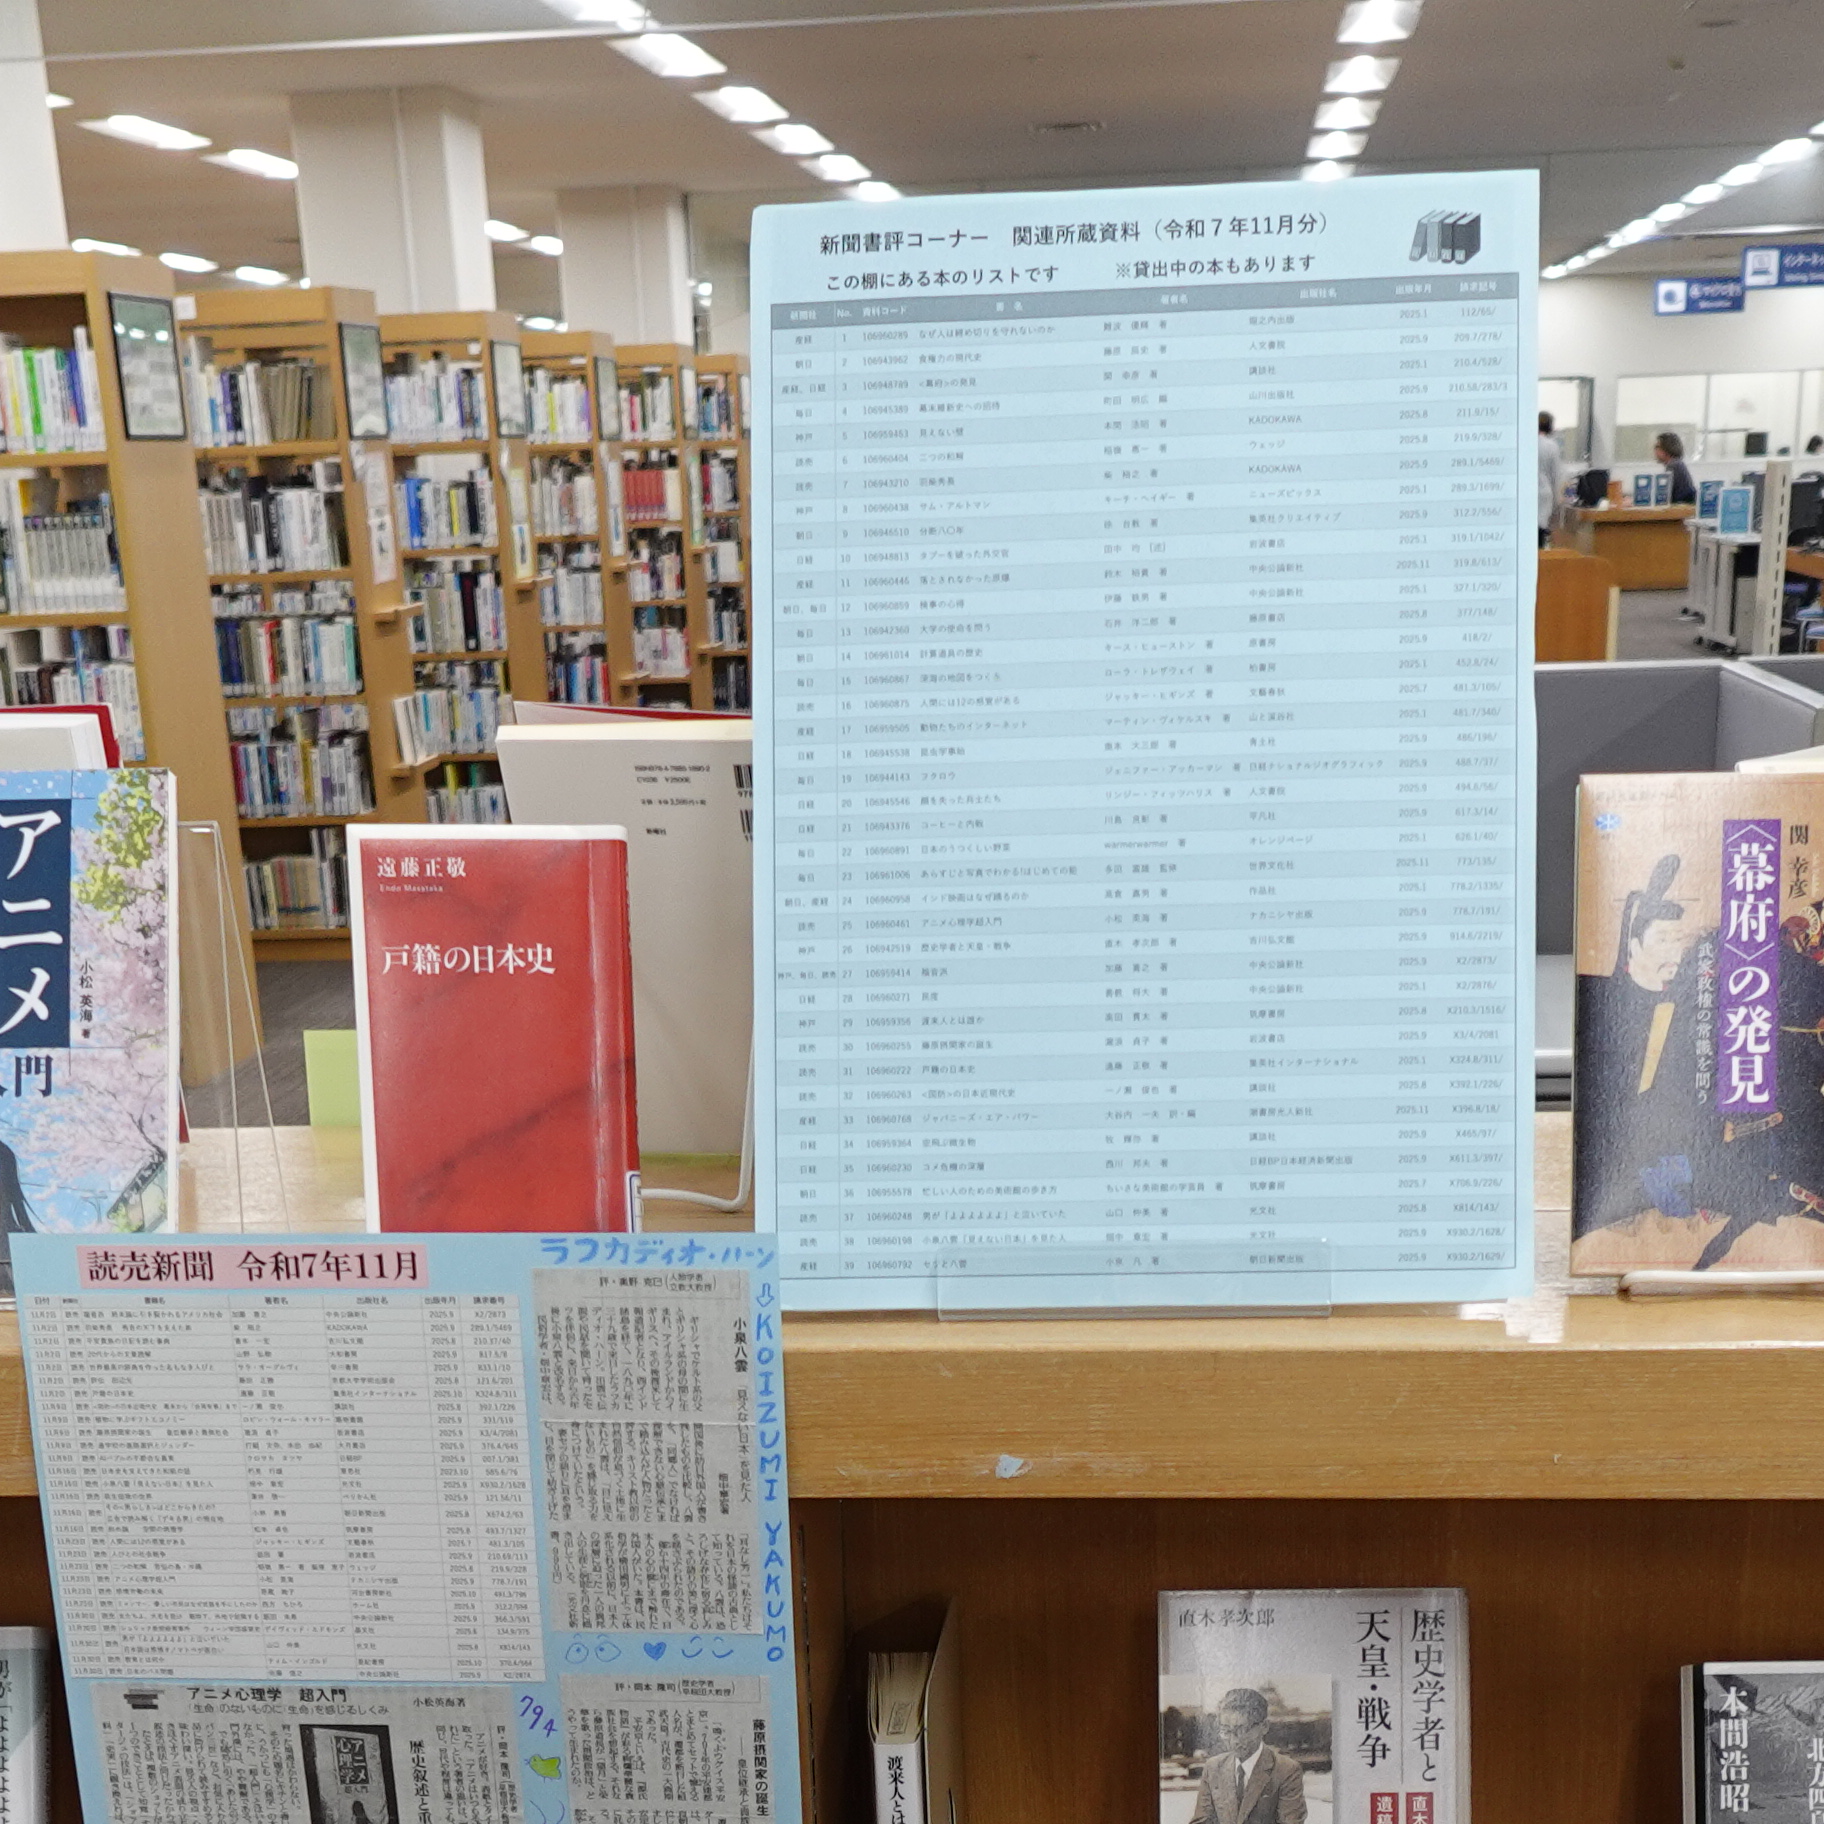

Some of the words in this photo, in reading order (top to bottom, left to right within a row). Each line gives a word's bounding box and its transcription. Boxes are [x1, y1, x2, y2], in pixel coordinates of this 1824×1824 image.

[819, 228, 990, 256] 新聞書評コーナー
[826, 264, 1060, 292] この棚にある本のリストです
[1248, 462, 1304, 475] KADOKAWA
[1789, 824, 1809, 846] 関
[376, 856, 467, 879] 遠藤正敬
[1788, 856, 1809, 900] 幸彦
[79, 960, 94, 990] 小松
[381, 942, 557, 976] 戸籍の日本史
[1722, 823, 1778, 1105] 〈幕府〉の発見
[79, 994, 94, 1024] 英海
[1695, 943, 1714, 1106] 武家政権の常識を問う
[87, 1249, 216, 1286] 読売新聞
[237, 1248, 422, 1284] 令和7年11月
[732, 1316, 749, 1373] 小泉八雲
[754, 1313, 782, 1502] KOIZUMI
[763, 1520, 787, 1662] YAKUMO
[1178, 1608, 1276, 1628] 直木孝次郎
[186, 1686, 284, 1705] アニメ心理学
[299, 1687, 349, 1704] 超入門
[1355, 1608, 1393, 1769] 天皇・戦争
[1410, 1608, 1447, 1783] 歴史学者と
[750, 1718, 772, 1817] 藤原摂関家の誕生
[1718, 1685, 1750, 1813] 本間浩昭
